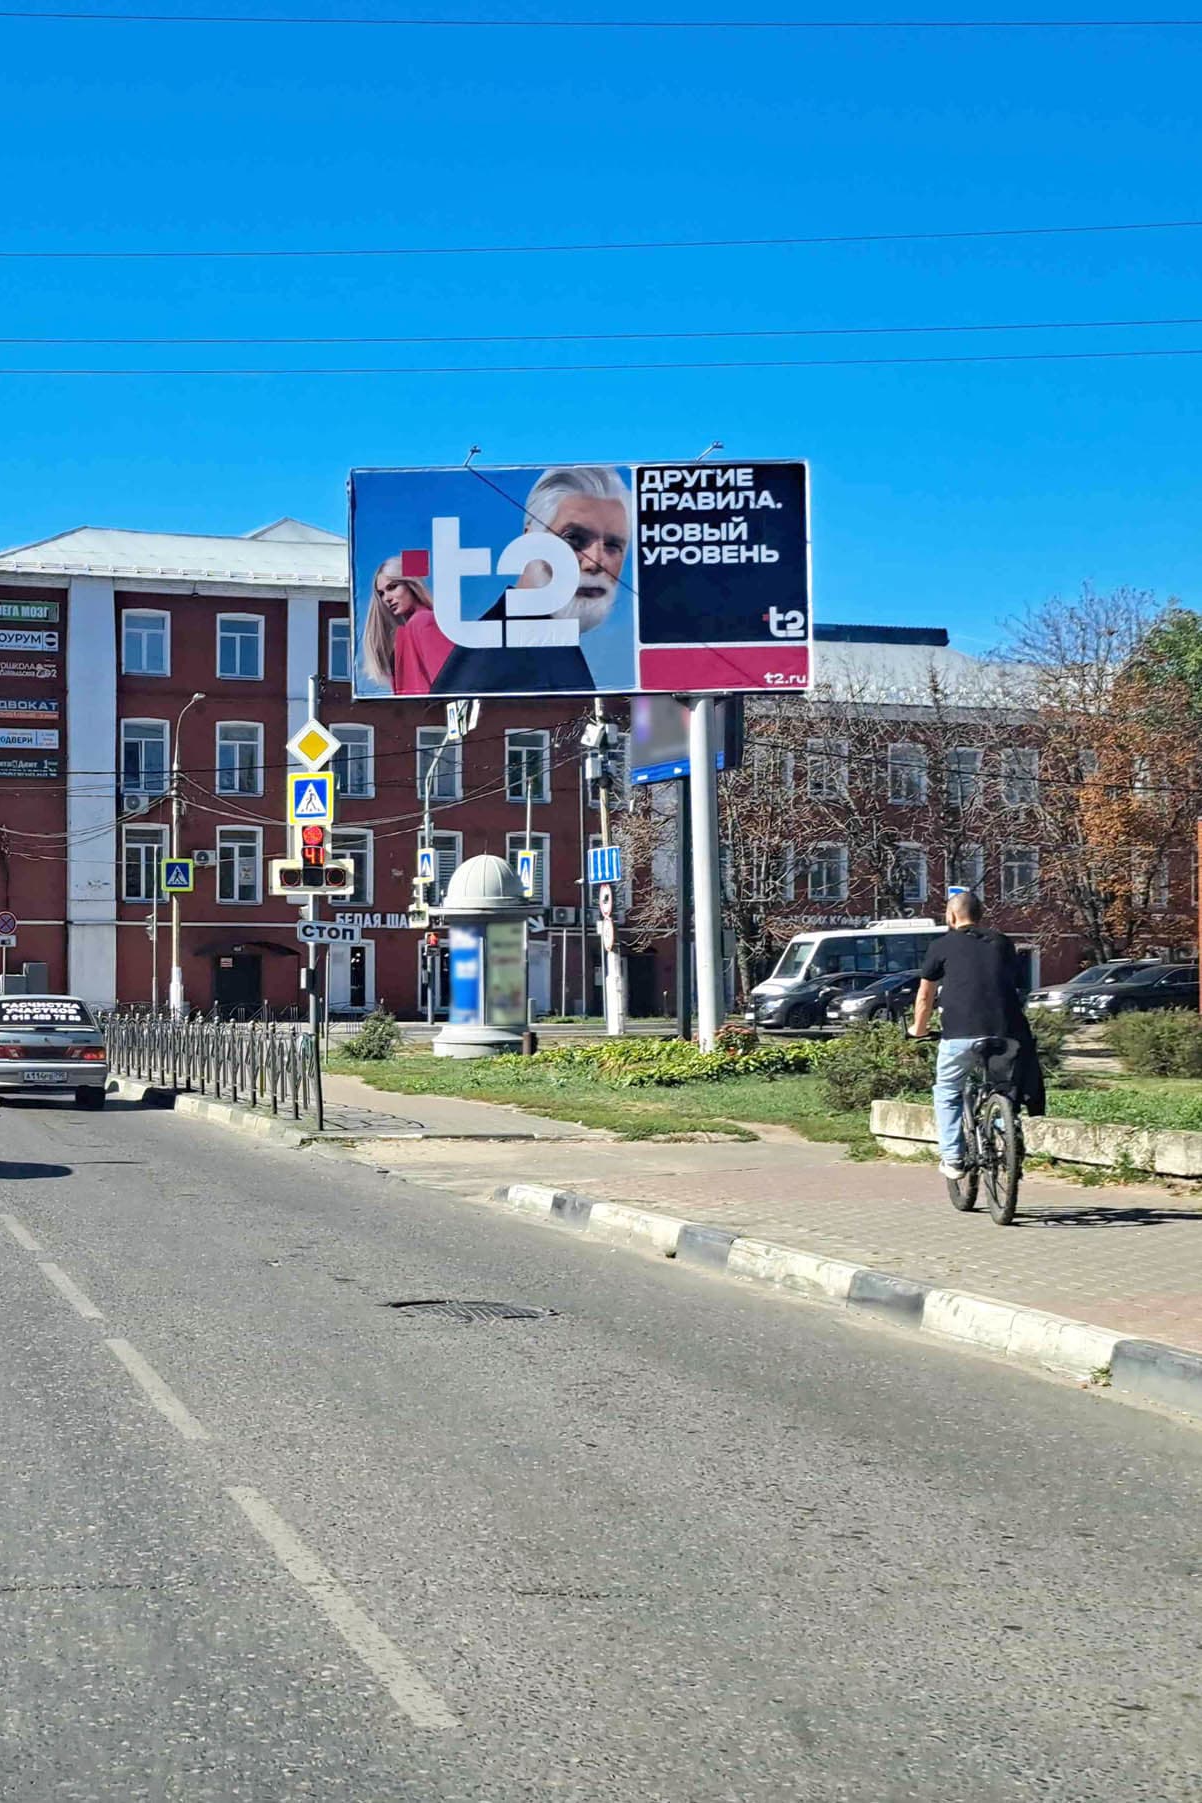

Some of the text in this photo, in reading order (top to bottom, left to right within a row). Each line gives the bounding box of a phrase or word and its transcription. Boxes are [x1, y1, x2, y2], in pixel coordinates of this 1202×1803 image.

[640, 468, 754, 492] ДРУГИЕ
[640, 490, 783, 511] ПРАВИЛА.
[640, 516, 748, 543] НОВЫЙ
[641, 544, 780, 566] УРОВЕНЬ
[431, 516, 580, 649] t2
[21, 605, 50, 618] МОЗГ
[769, 606, 805, 638] t2
[763, 672, 806, 685] t2.ru
[335, 912, 382, 929] БЕЛАЯ
[301, 925, 355, 941] СТОП
[1, 1002, 81, 1010] РАСЧИСТКА
